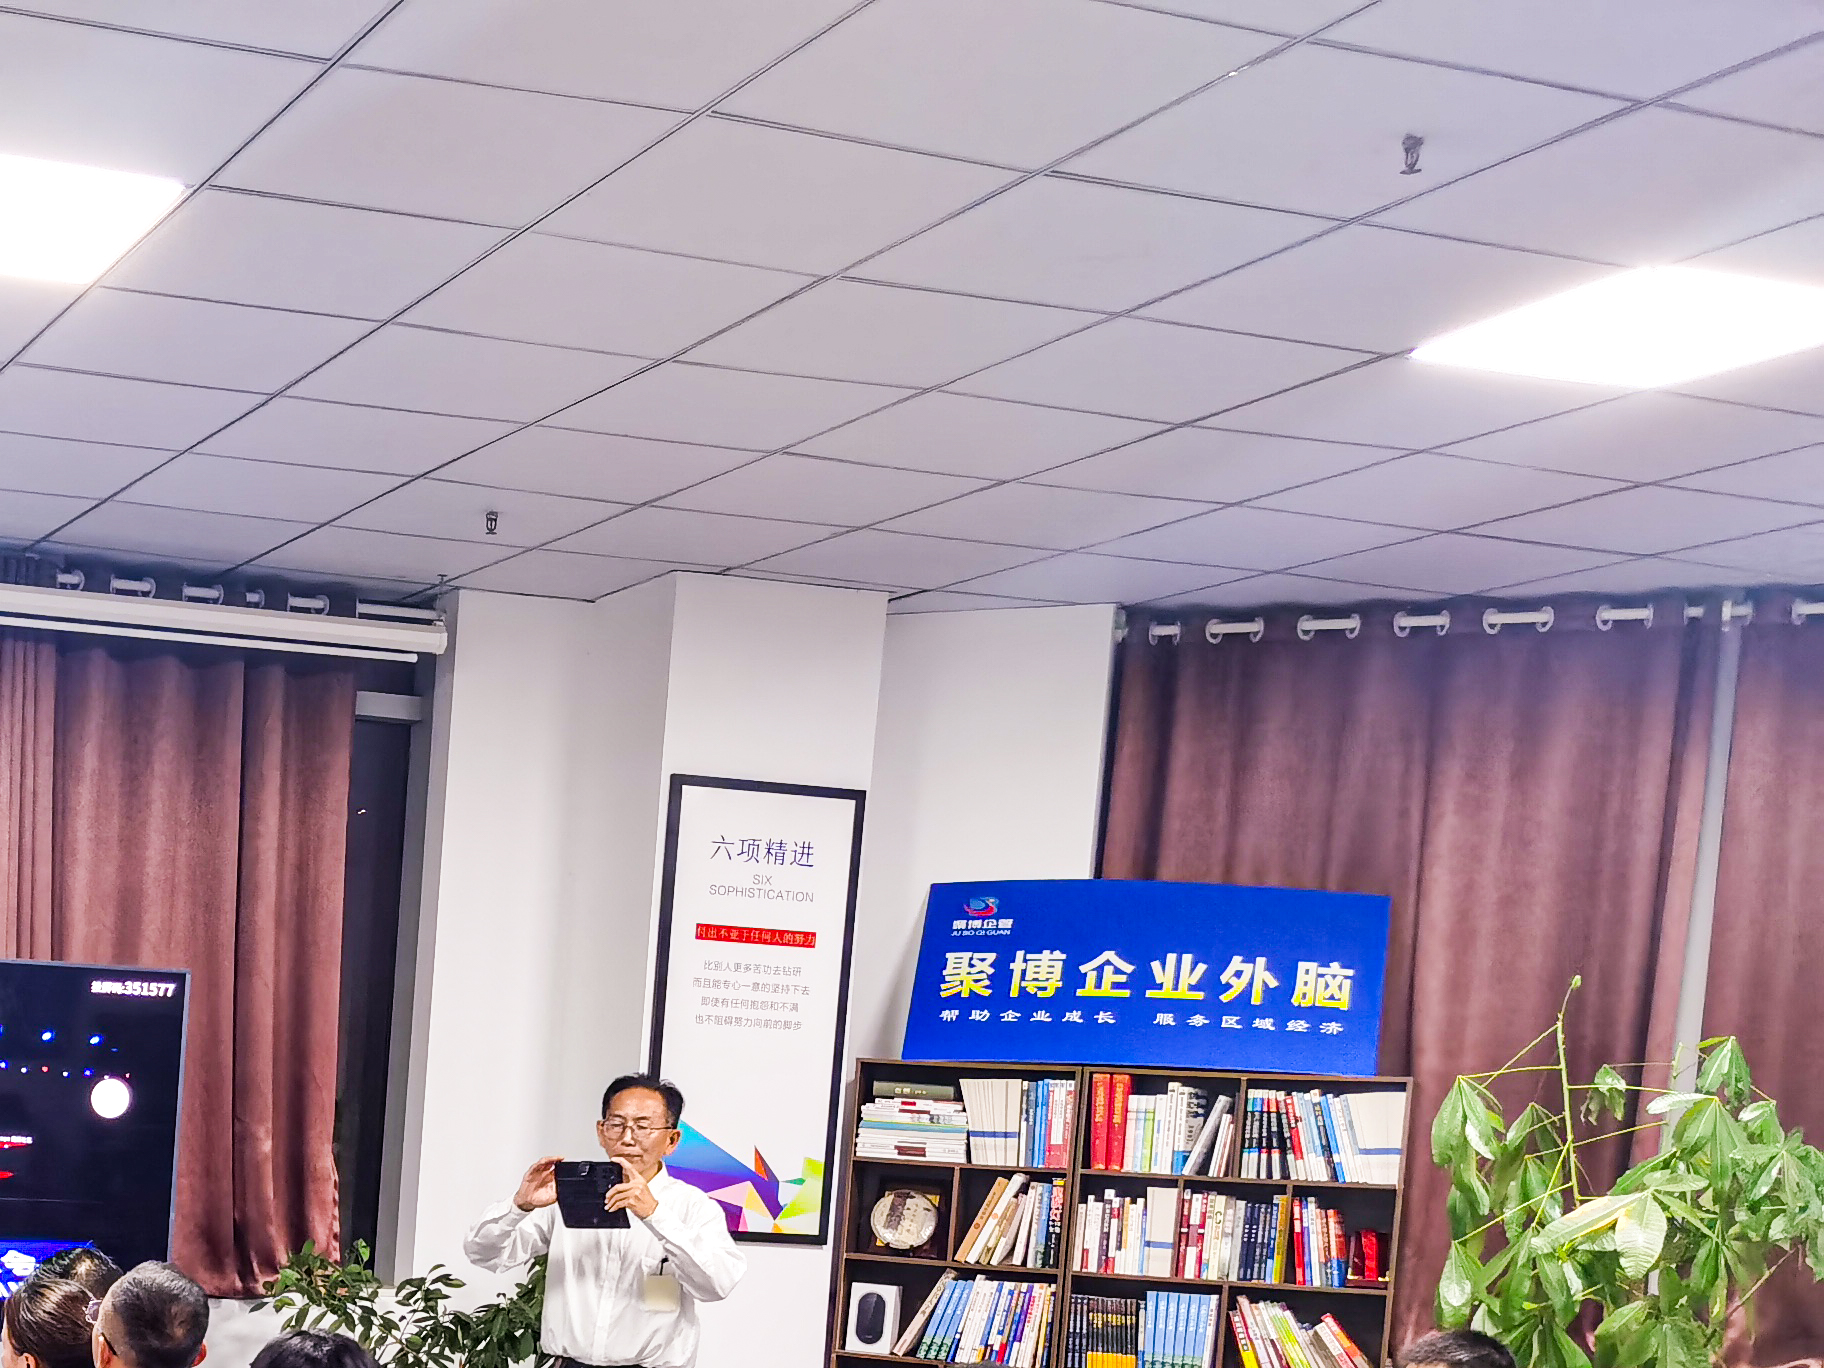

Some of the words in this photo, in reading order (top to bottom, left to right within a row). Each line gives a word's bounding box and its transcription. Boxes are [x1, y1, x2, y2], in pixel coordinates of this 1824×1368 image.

[710, 835, 814, 867] 六项精进
[752, 874, 773, 886] SIX
[709, 884, 814, 902] SOPHISTICATION
[697, 926, 816, 946] 付出不亚于任何人的努力
[703, 960, 802, 977] 比别人更多苦功去钻研
[939, 950, 1354, 1011] 聚博企业外脑
[939, 1009, 1116, 1024] 帮助企业成长
[1153, 1012, 1344, 1035] 服务区域经济
